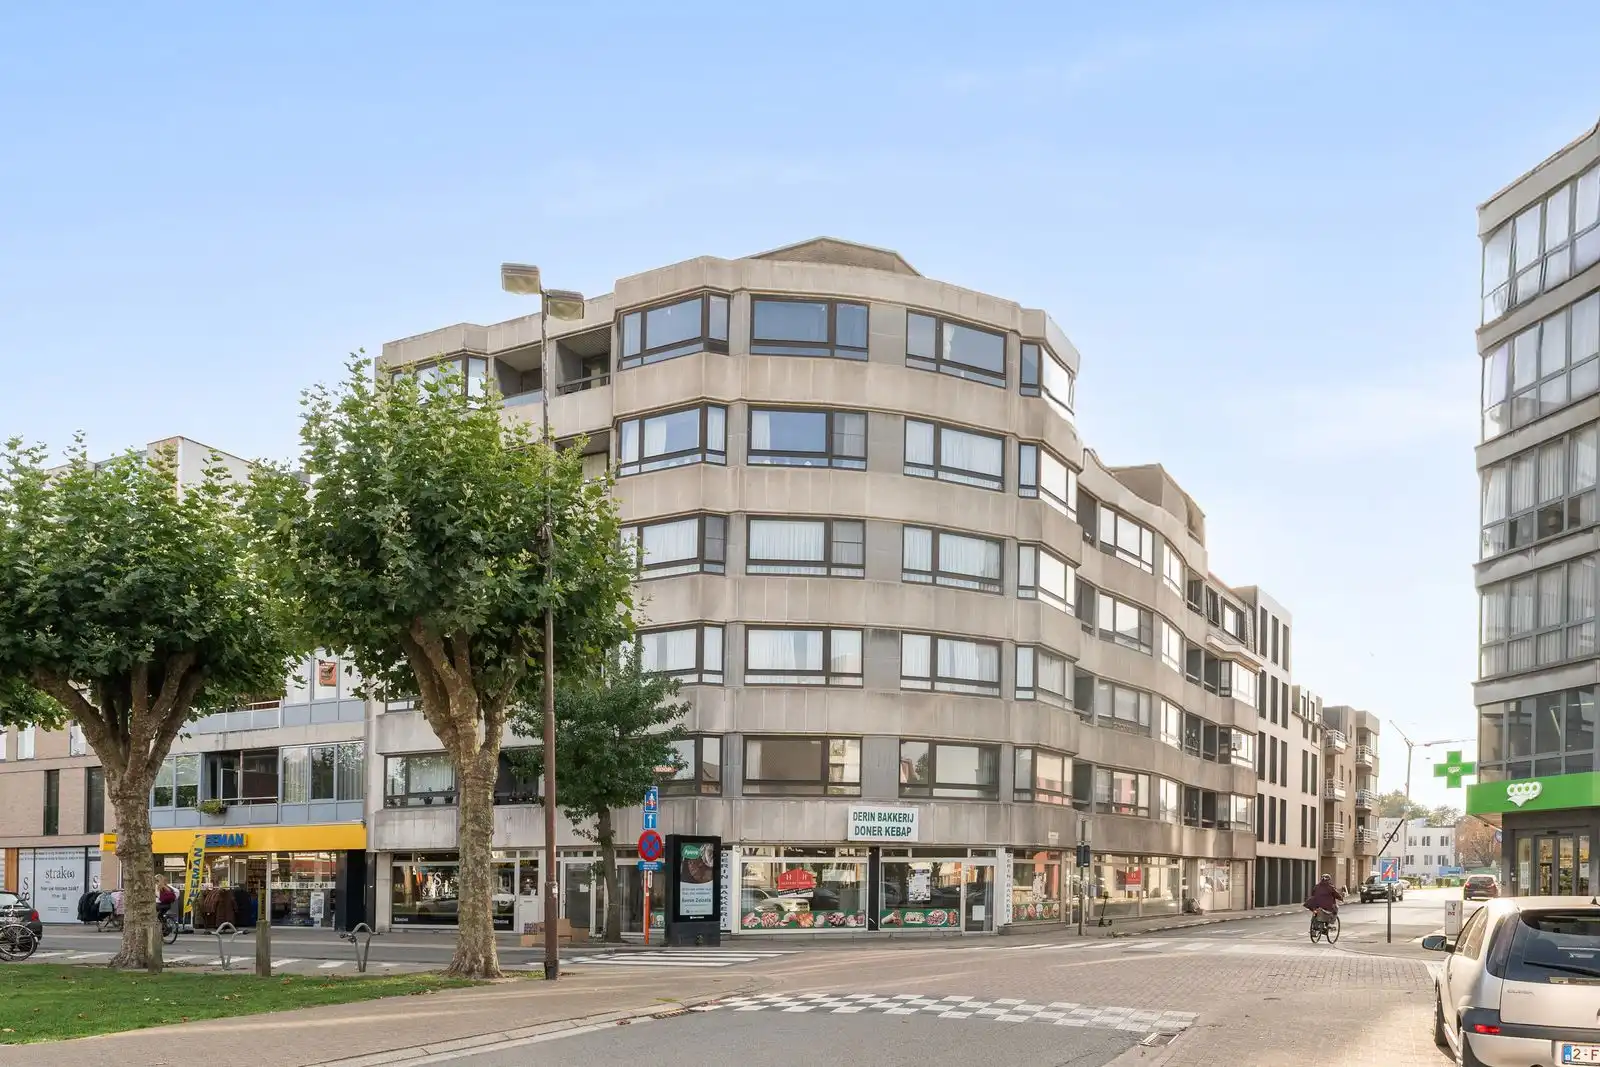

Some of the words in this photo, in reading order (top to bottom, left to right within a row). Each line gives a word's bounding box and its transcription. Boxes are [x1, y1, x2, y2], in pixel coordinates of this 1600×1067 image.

[853, 811, 876, 822] DERIN
[877, 812, 914, 823] BAKKERIJ
[854, 826, 883, 836] DONER
[884, 826, 912, 837] KEBAP
[1384, 832, 1399, 843] 30
[196, 832, 244, 847] EEMAN
[45, 865, 75, 879] strak(s)
[721, 853, 729, 880] DERIN
[187, 848, 203, 905] ZEEMAN
[720, 885, 729, 928] BAKKERIJ
